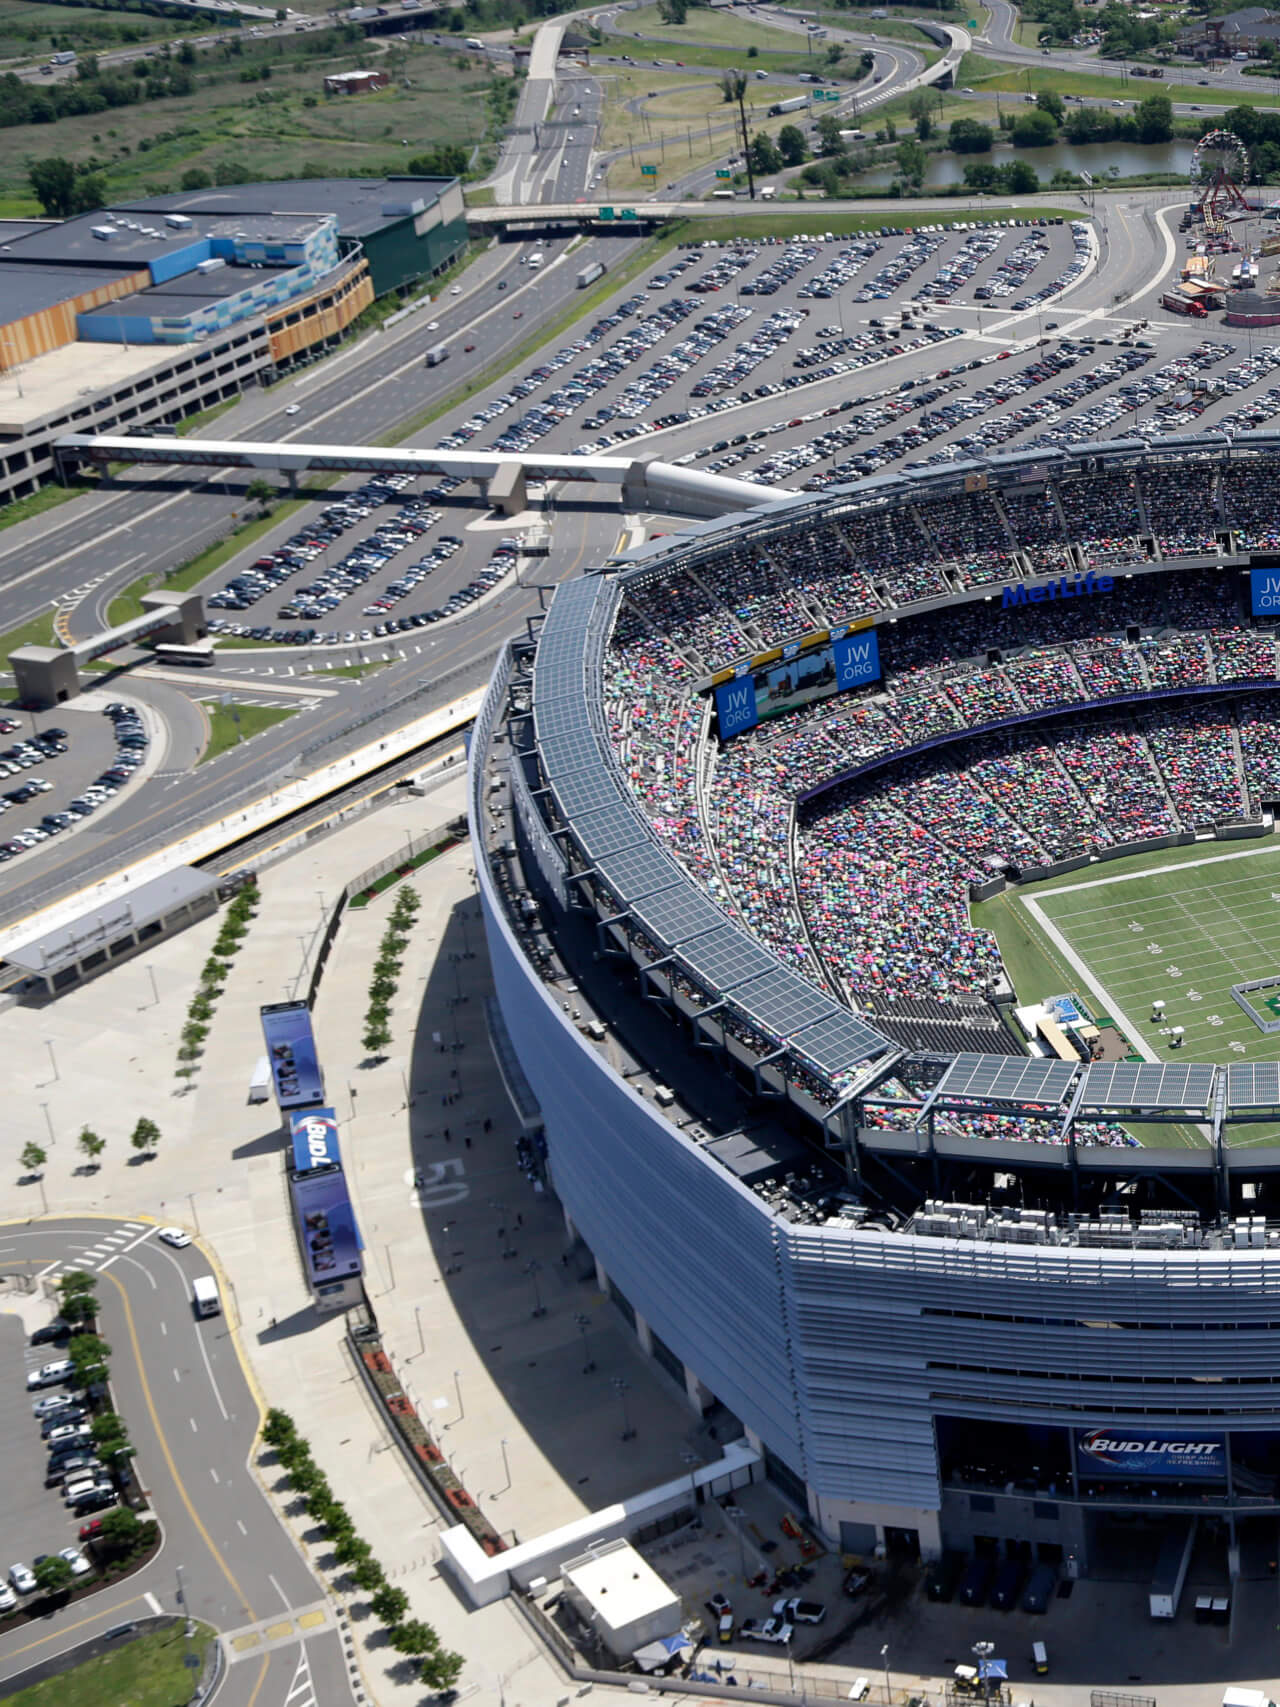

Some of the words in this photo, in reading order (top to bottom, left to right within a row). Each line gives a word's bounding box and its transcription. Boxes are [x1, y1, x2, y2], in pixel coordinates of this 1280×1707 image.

[1002, 571, 1114, 608] MetLife
[843, 642, 870, 667] JW
[842, 661, 873, 681] .ORG
[724, 687, 748, 714] JW
[724, 706, 751, 729] .ORG
[1206, 1015, 1224, 1026] 50
[307, 1124, 327, 1157] BUD
[403, 1158, 470, 1208] 50
[1091, 1439, 1144, 1453] BUD
[1145, 1441, 1221, 1455] LIGHT
